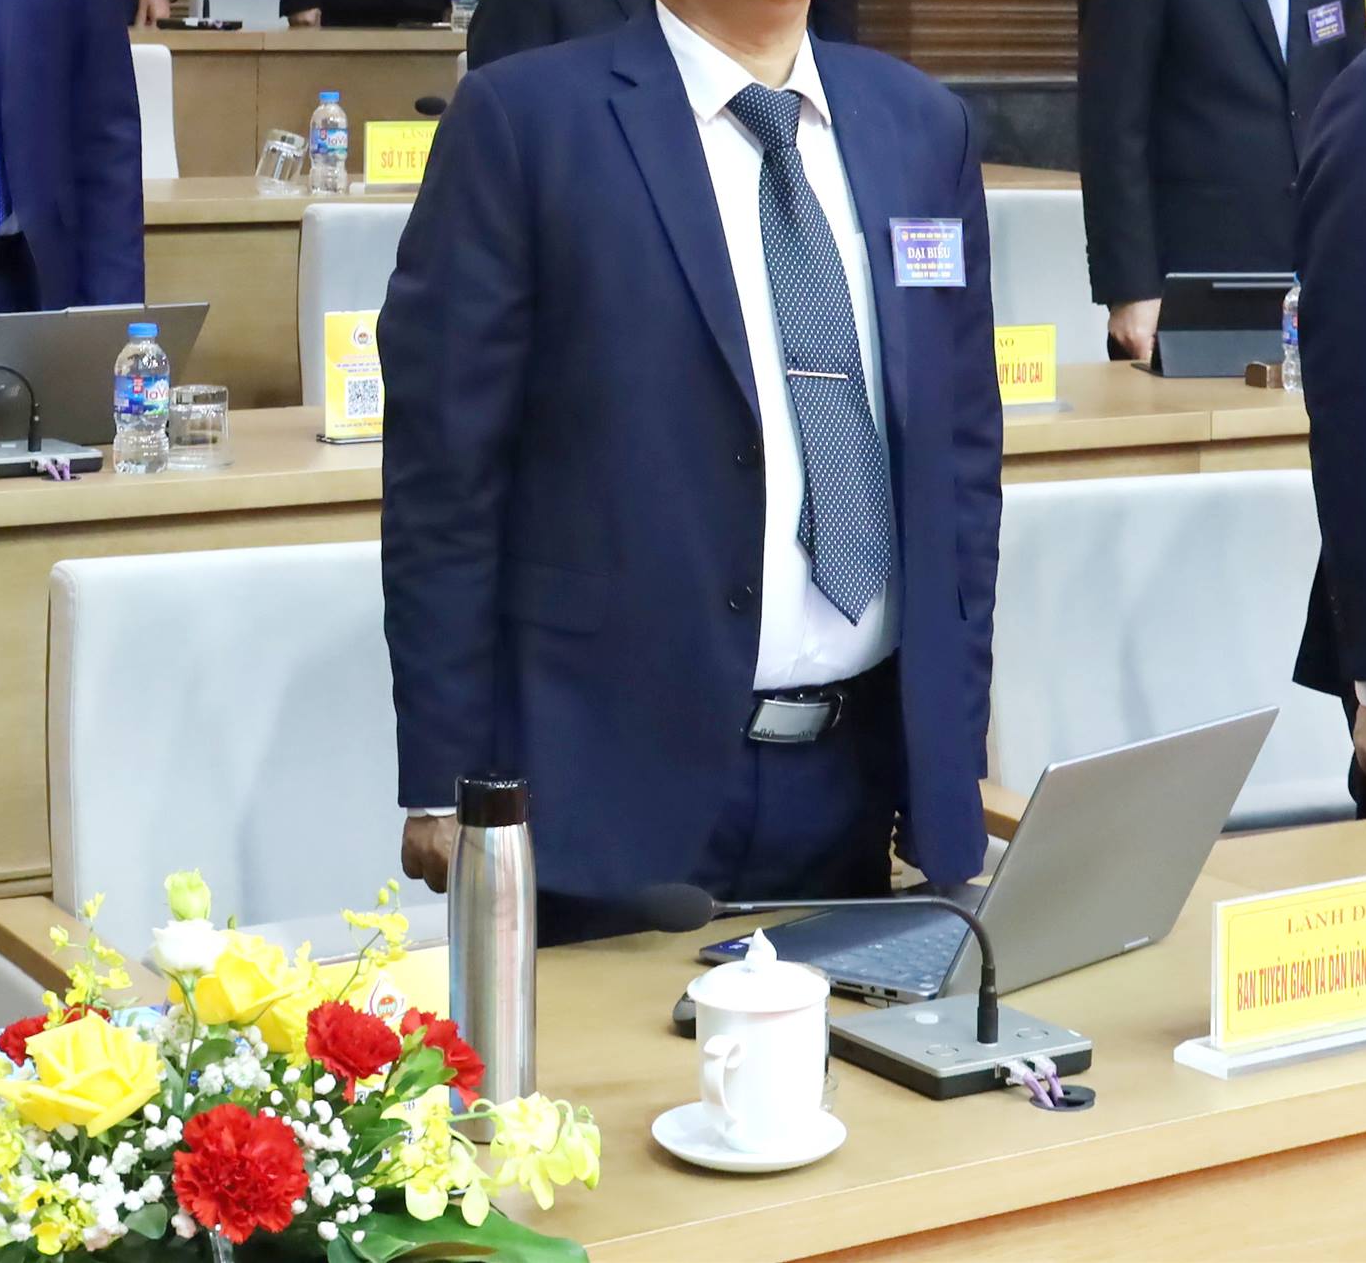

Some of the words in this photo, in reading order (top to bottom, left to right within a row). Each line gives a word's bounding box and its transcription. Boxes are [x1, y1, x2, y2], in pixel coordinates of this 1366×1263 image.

[907, 246, 925, 261] ĐẠI
[927, 241, 951, 259] BIỂU
[1029, 361, 1043, 384] CAI
[1237, 969, 1256, 1012] BAN
[1259, 955, 1288, 1008] TUYÊN
[1290, 950, 1312, 1001] GIÁO
[1314, 947, 1327, 996] VÀ
[1329, 944, 1347, 994] DÂN
